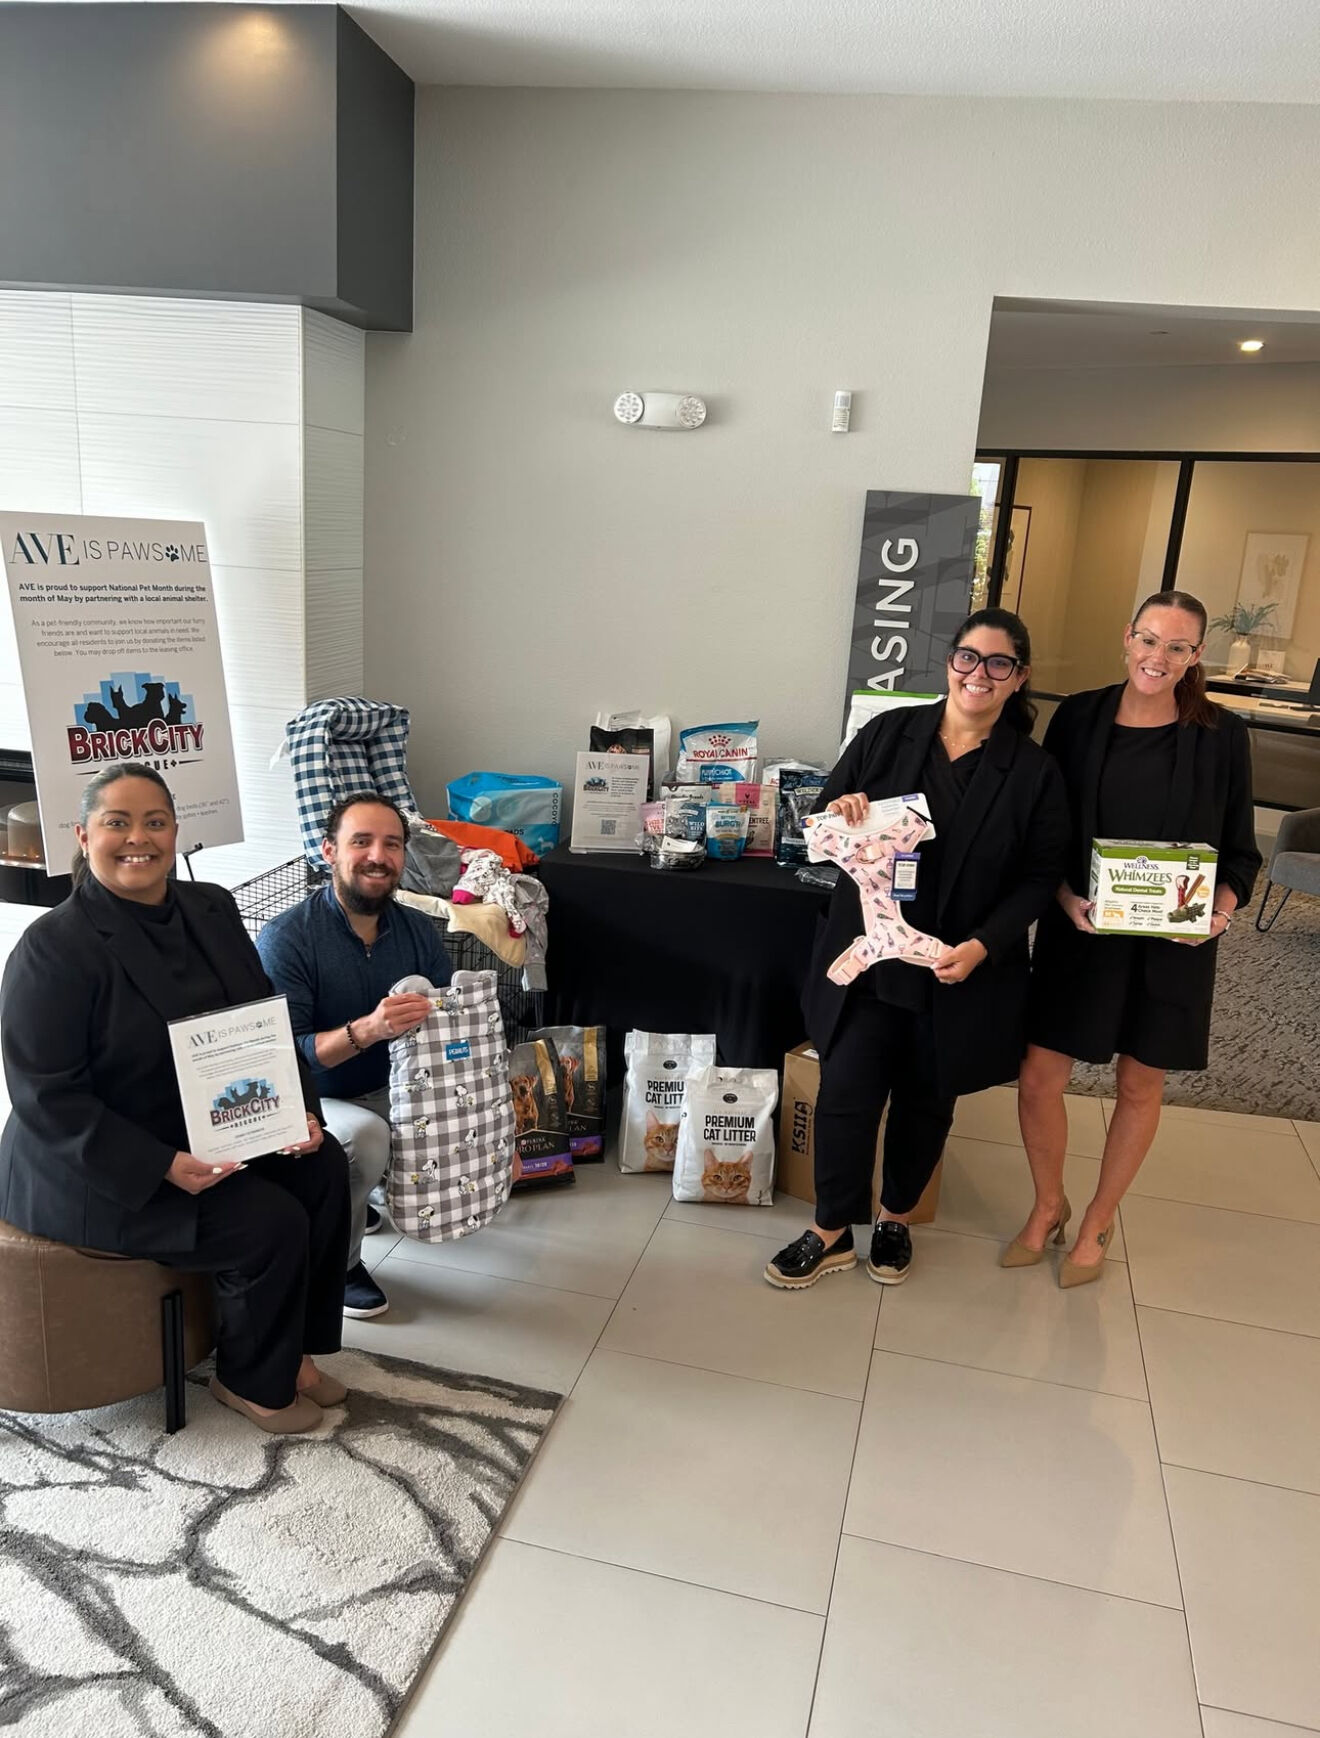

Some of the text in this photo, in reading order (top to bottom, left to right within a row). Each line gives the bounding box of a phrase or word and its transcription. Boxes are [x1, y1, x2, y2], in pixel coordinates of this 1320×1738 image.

[8, 532, 80, 566] AVE
[83, 540, 102, 560] IS
[19, 583, 35, 591] AVE
[37, 583, 44, 591] is
[45, 584, 68, 592] proud
[175, 585, 195, 593] during
[47, 594, 56, 602] of
[57, 595, 73, 603] May
[74, 595, 84, 603] by
[85, 595, 122, 604] partnering
[867, 537, 920, 692] ASING
[718, 748, 748, 758] CANIN
[1124, 862, 1160, 871] WELLNESS
[1131, 903, 1138, 913] 4
[187, 1029, 218, 1049] AVE
[647, 1080, 685, 1093] PREMIU
[645, 1092, 685, 1106] CAT LITT
[705, 1114, 755, 1129] PREMIUM
[703, 1128, 756, 1142] CAT LITTER
